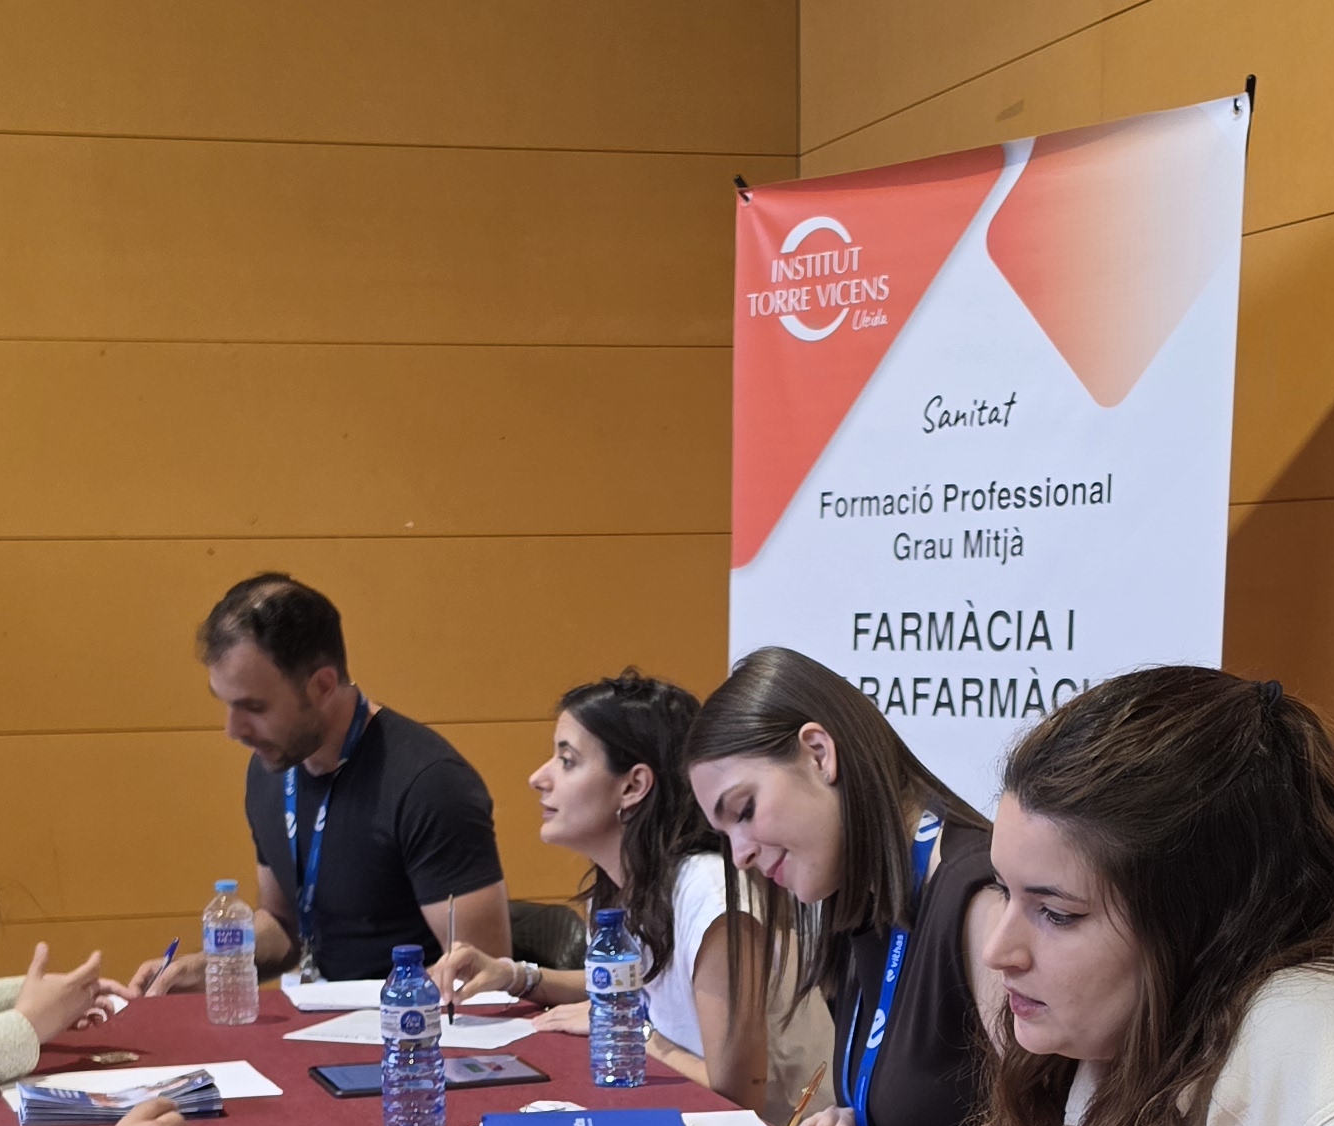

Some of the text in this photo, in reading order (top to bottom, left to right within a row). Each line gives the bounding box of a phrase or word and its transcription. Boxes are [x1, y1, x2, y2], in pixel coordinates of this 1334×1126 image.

[771, 247, 863, 283] INSTITUT
[746, 274, 889, 317] TORRE VICENS
[852, 308, 889, 331] Lleida
[922, 391, 1017, 434] Sanitat
[820, 473, 1112, 519] Formació Professional
[893, 526, 1024, 566] Grau Mitjà
[853, 600, 1075, 652] FARMÀCIA I
